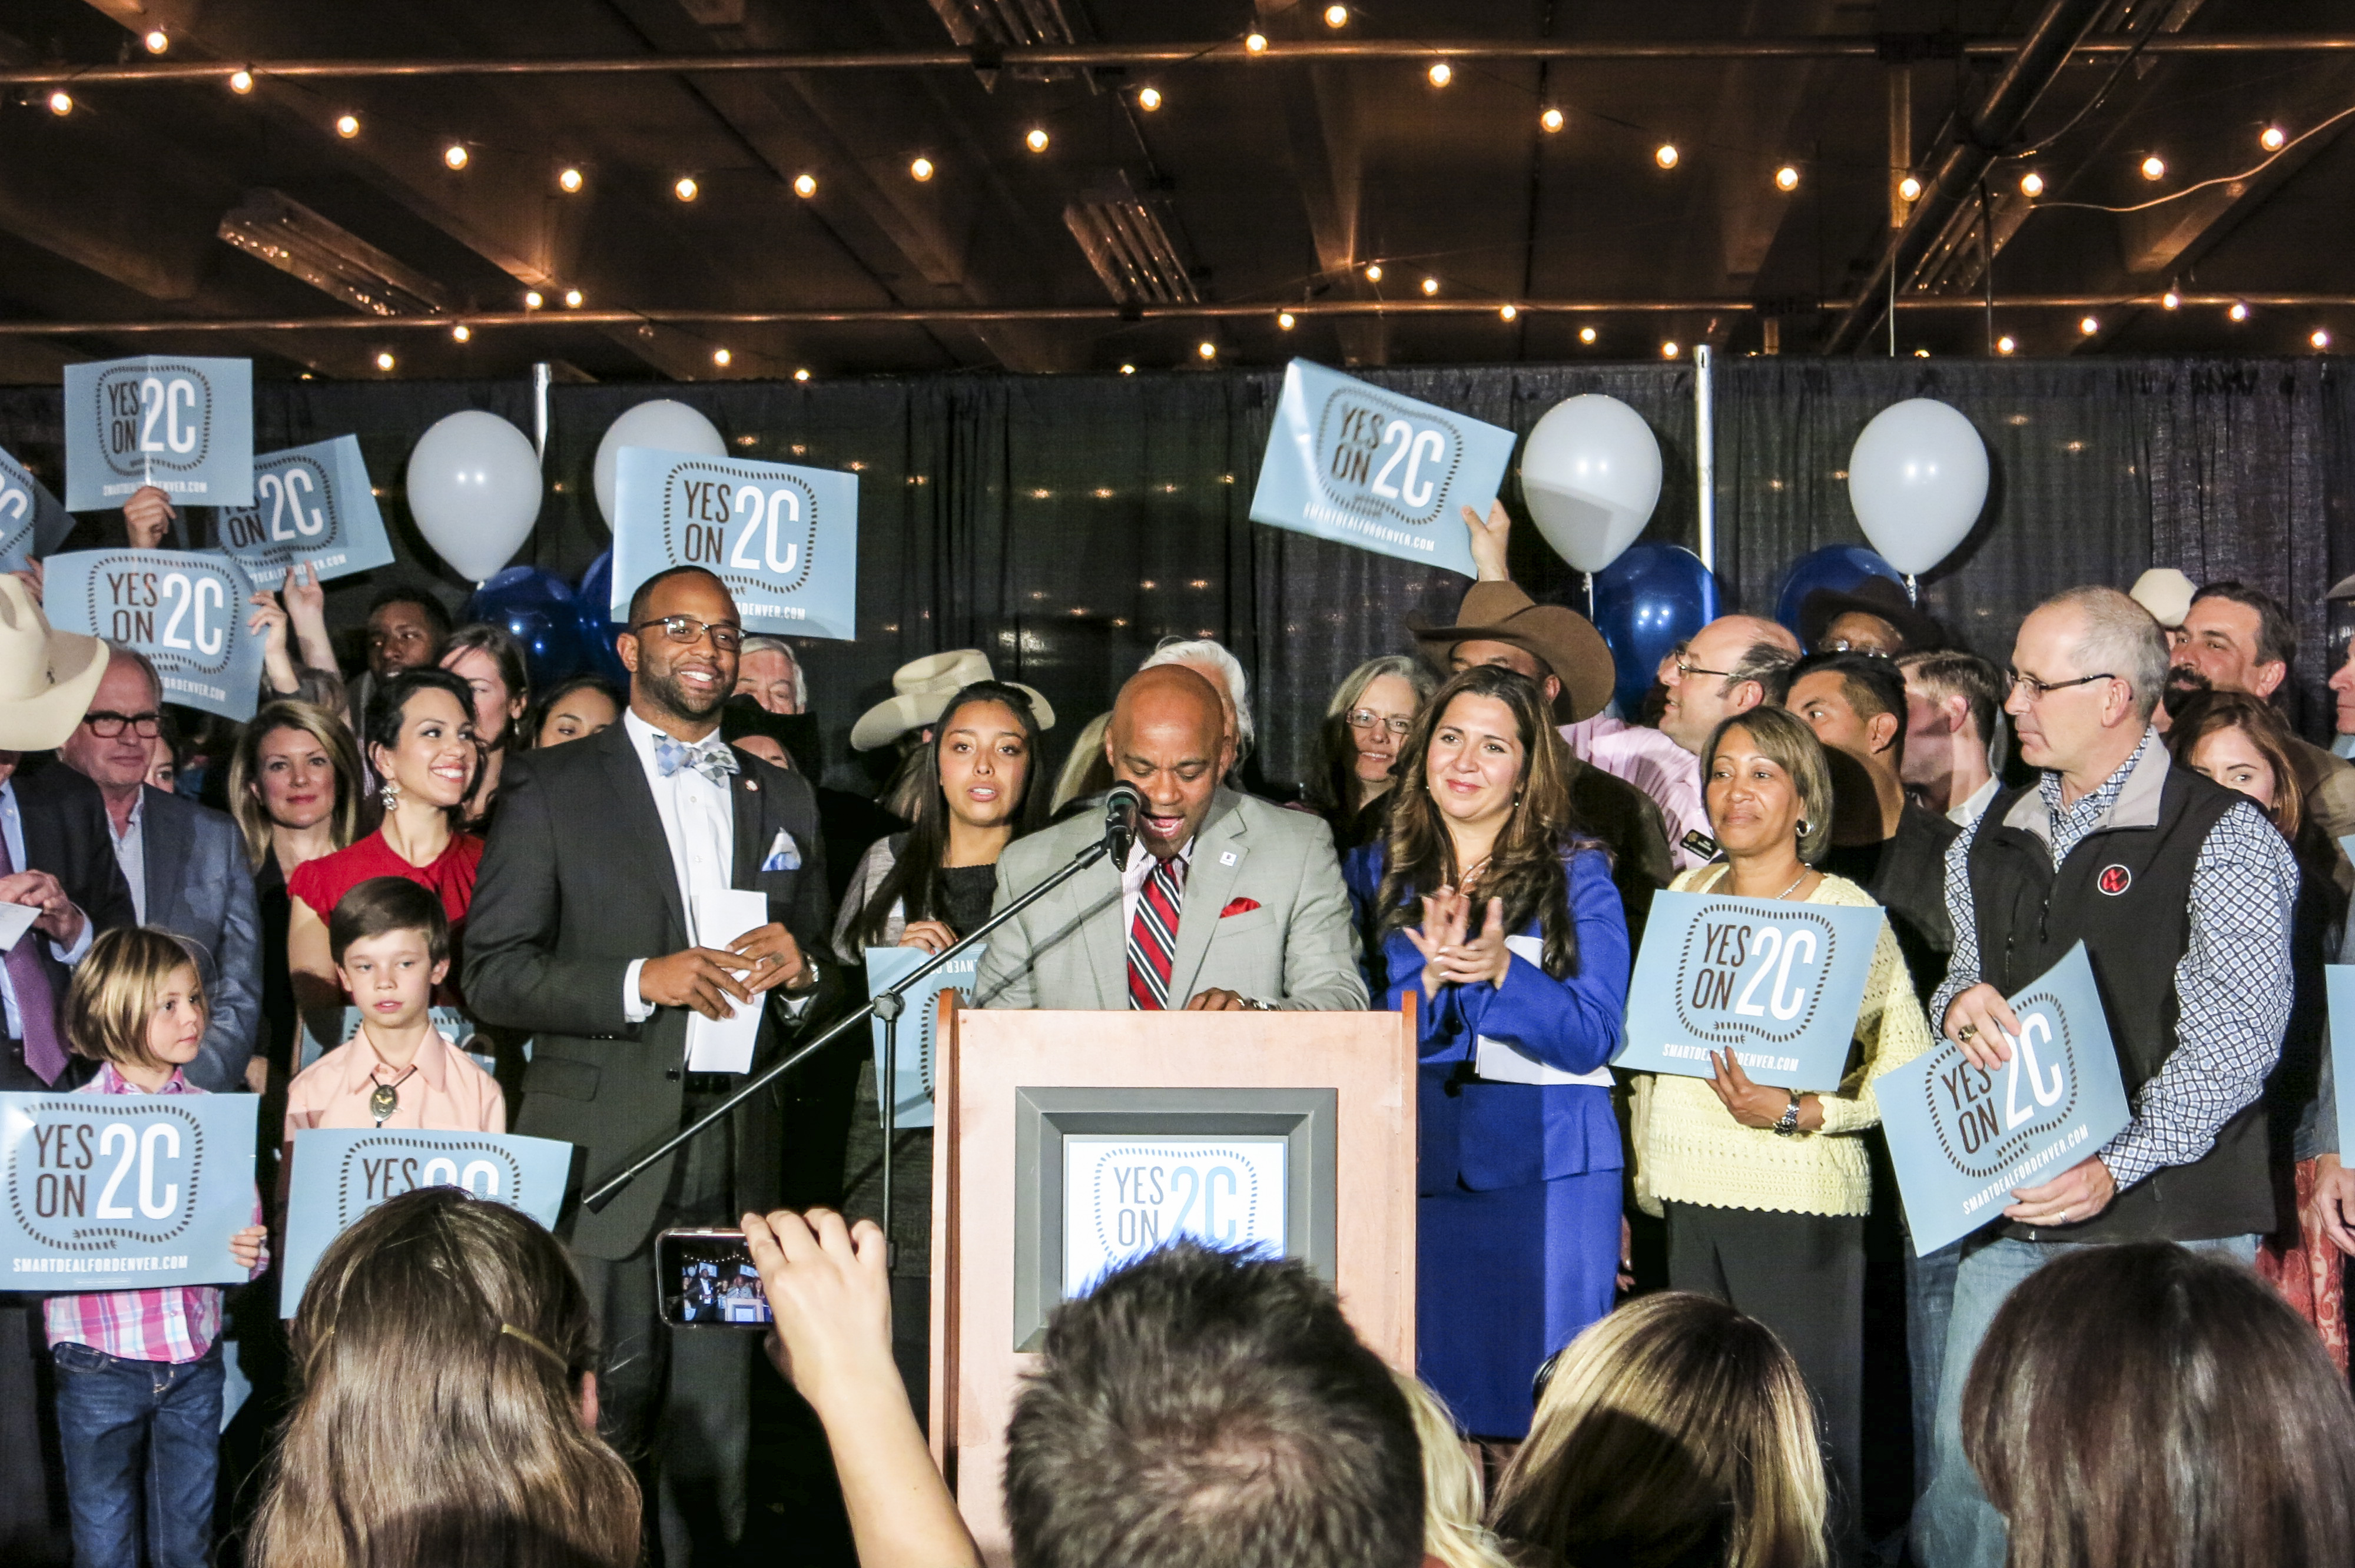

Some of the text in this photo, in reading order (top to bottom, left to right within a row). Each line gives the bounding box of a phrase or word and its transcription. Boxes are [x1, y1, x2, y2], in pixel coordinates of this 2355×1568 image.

[108, 380, 140, 417] YES
[112, 377, 195, 454] ON 2C
[1341, 401, 1385, 450] YES
[1332, 420, 1445, 507] ON 2C
[228, 469, 323, 548] ON 2C
[684, 480, 731, 524] YES
[685, 485, 800, 573] ON 2C
[107, 572, 158, 607] YES
[113, 572, 223, 655] ON 2C
[1691, 926, 1817, 1021] ON 2C
[1703, 923, 1751, 967] YES
[1941, 1059, 1992, 1111] YES
[1958, 1012, 2063, 1154] ON 2C
[34, 1124, 94, 1170] YES
[35, 1122, 180, 1220] ON 2C
[363, 1157, 418, 1200] YES
[1962, 1124, 2089, 1215] SMARTDEALFORDENVER.COM
[1113, 1165, 1164, 1205] YES
[1119, 1165, 1236, 1250] ON 2C
[13, 1255, 188, 1273] SMARTDEALFORDENVER.COM
